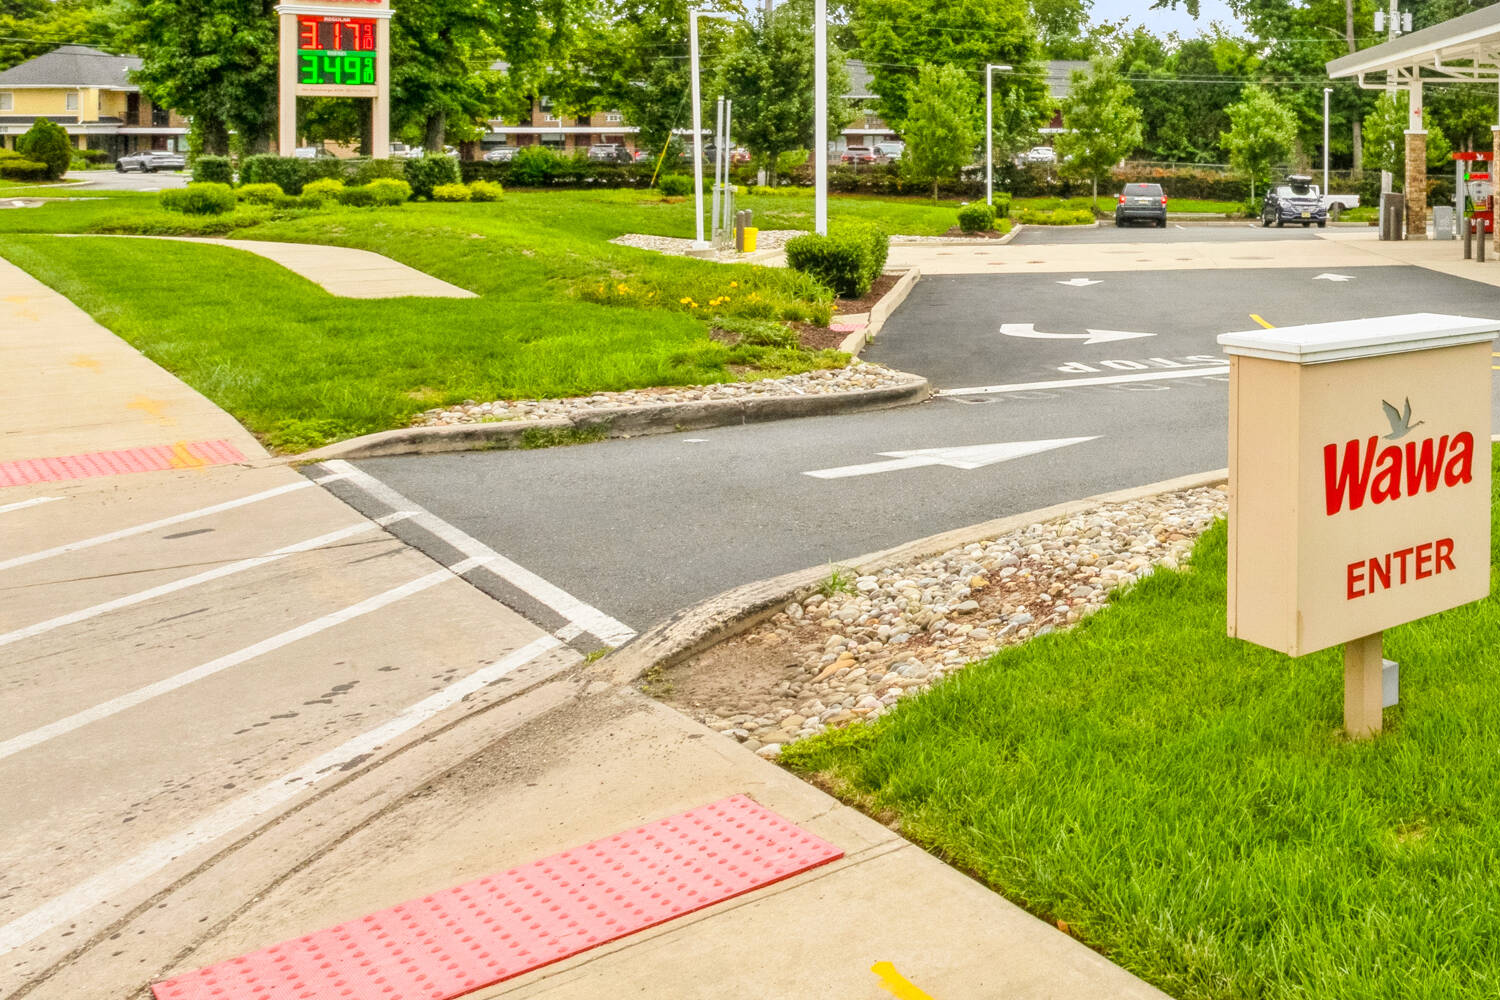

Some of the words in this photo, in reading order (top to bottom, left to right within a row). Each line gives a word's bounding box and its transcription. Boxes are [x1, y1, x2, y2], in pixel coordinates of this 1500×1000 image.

[301, 21, 360, 51] 3.17
[301, 55, 361, 85] 3.49
[1323, 431, 1475, 516] Wawa
[1347, 537, 1457, 600] ENTER
